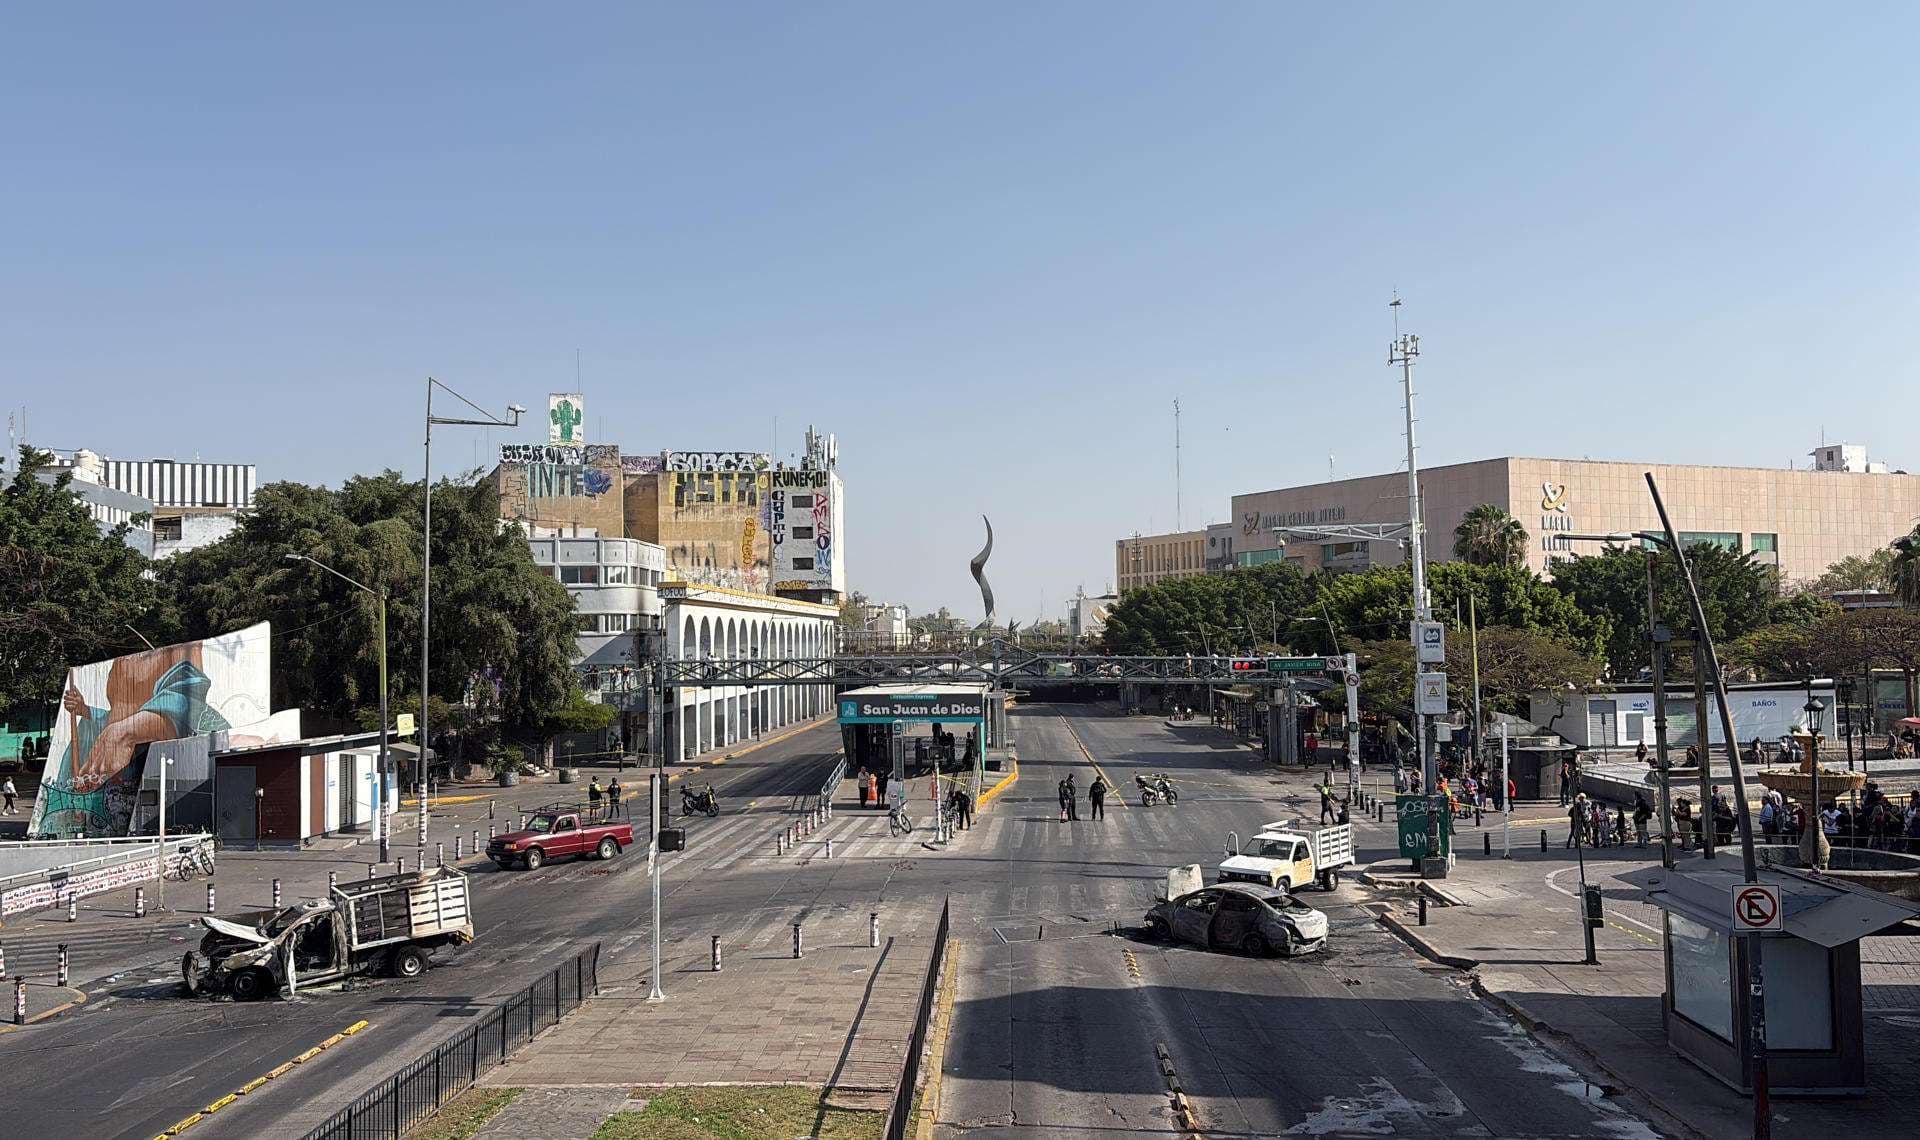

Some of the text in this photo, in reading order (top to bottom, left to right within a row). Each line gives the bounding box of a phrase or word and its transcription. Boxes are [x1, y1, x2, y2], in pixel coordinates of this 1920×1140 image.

[863, 704, 981, 715] San Juan de Dios
